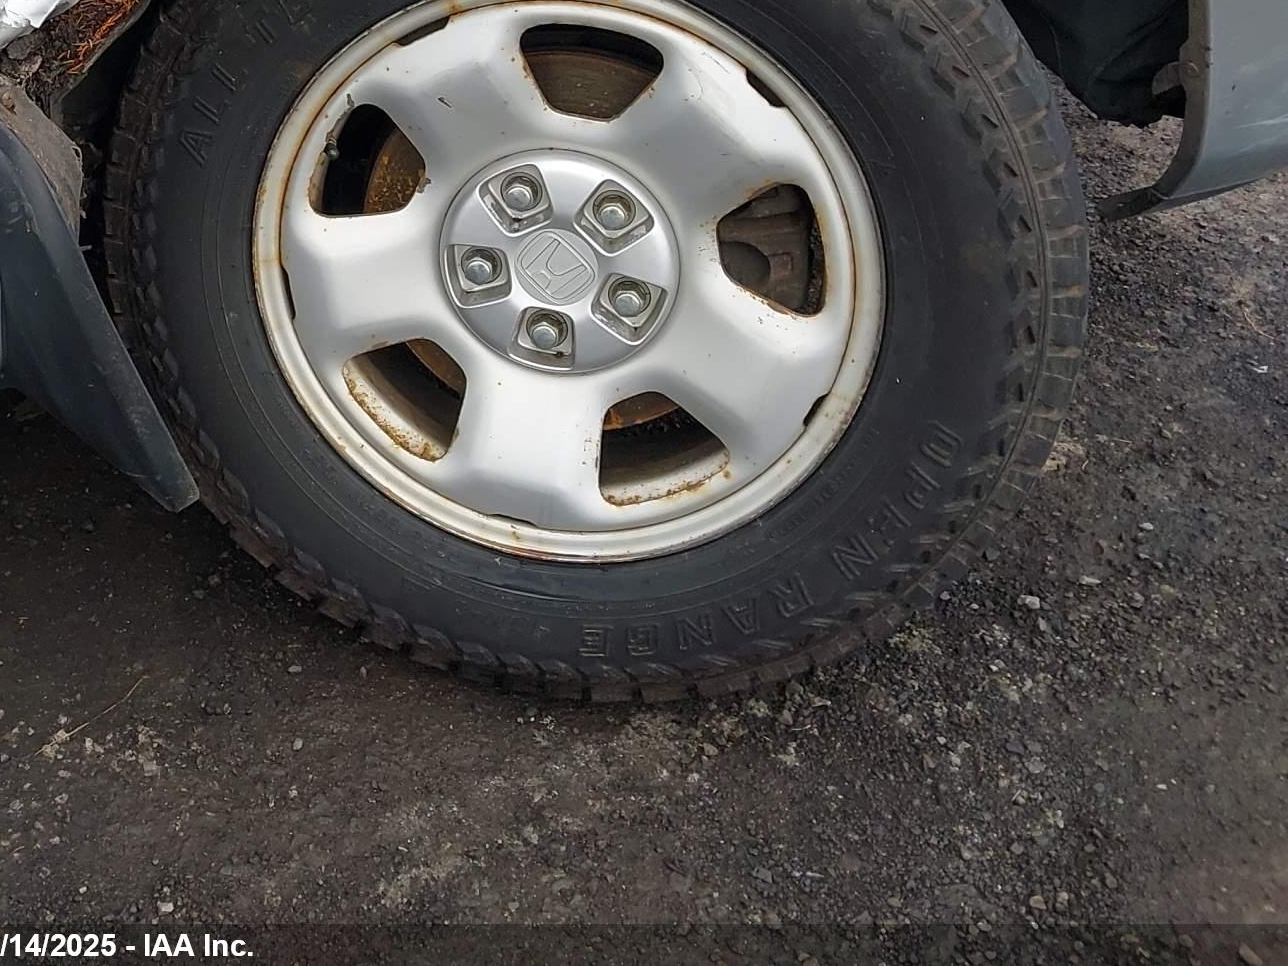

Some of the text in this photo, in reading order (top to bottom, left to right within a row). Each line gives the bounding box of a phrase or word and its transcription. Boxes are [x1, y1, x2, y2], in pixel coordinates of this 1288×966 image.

[178, 64, 239, 167] ALL
[829, 418, 965, 582] OPEN
[578, 571, 815, 658] RANGE
